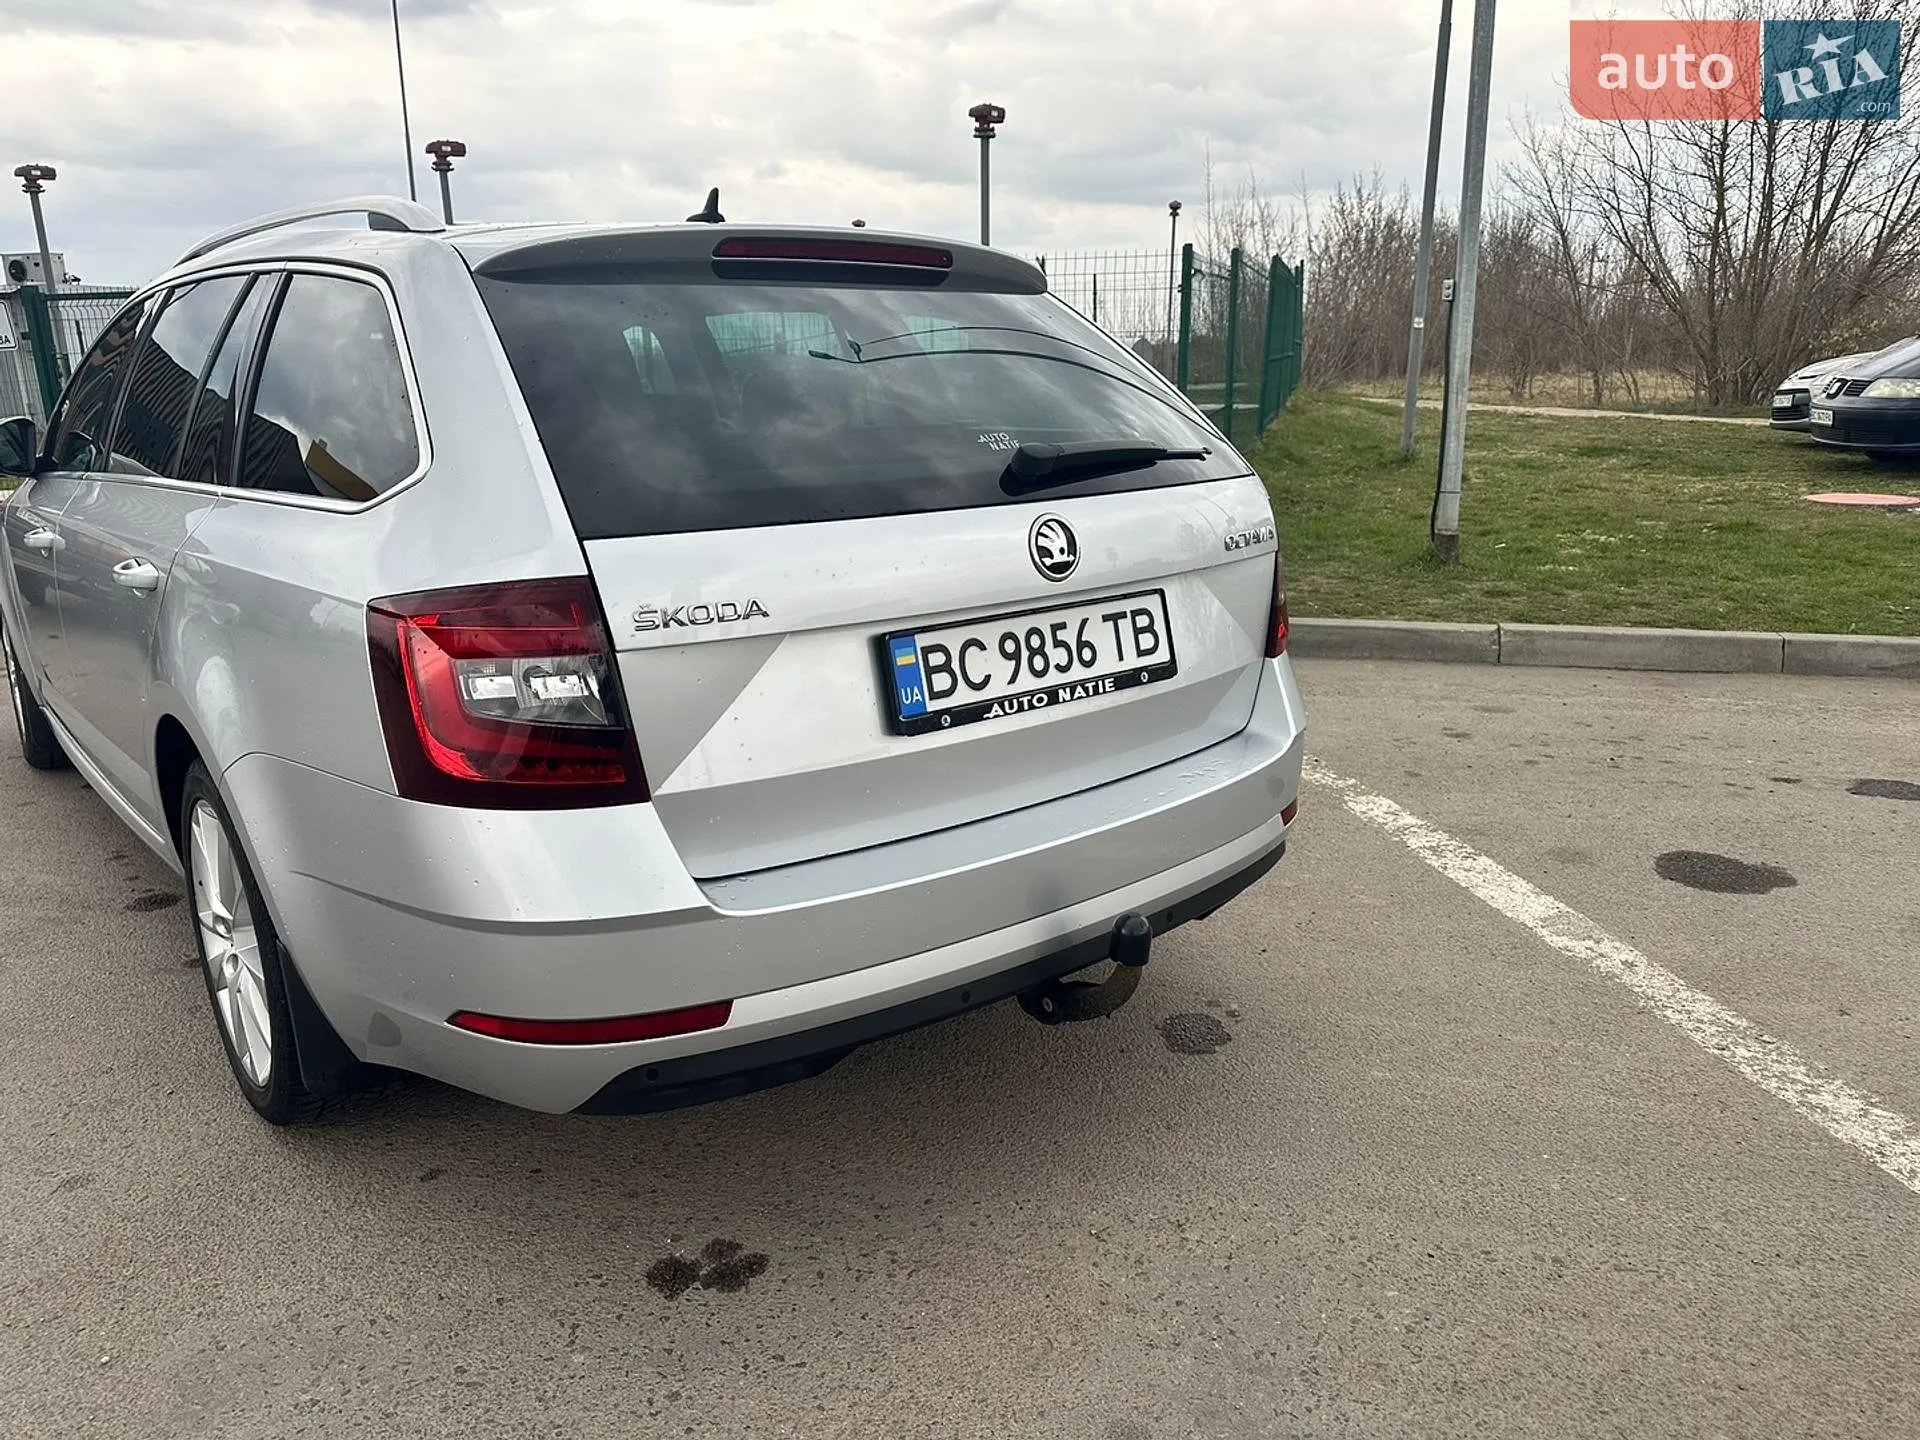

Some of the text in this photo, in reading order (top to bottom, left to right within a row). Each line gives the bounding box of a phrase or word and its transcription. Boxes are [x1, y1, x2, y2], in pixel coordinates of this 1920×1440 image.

[978, 432, 1010, 443] AUTO
[632, 598, 770, 632] ŠKODA
[920, 607, 1160, 701] BC 9856 TB
[901, 687, 922, 704] UA
[983, 678, 1116, 718] AUTO NATIE
